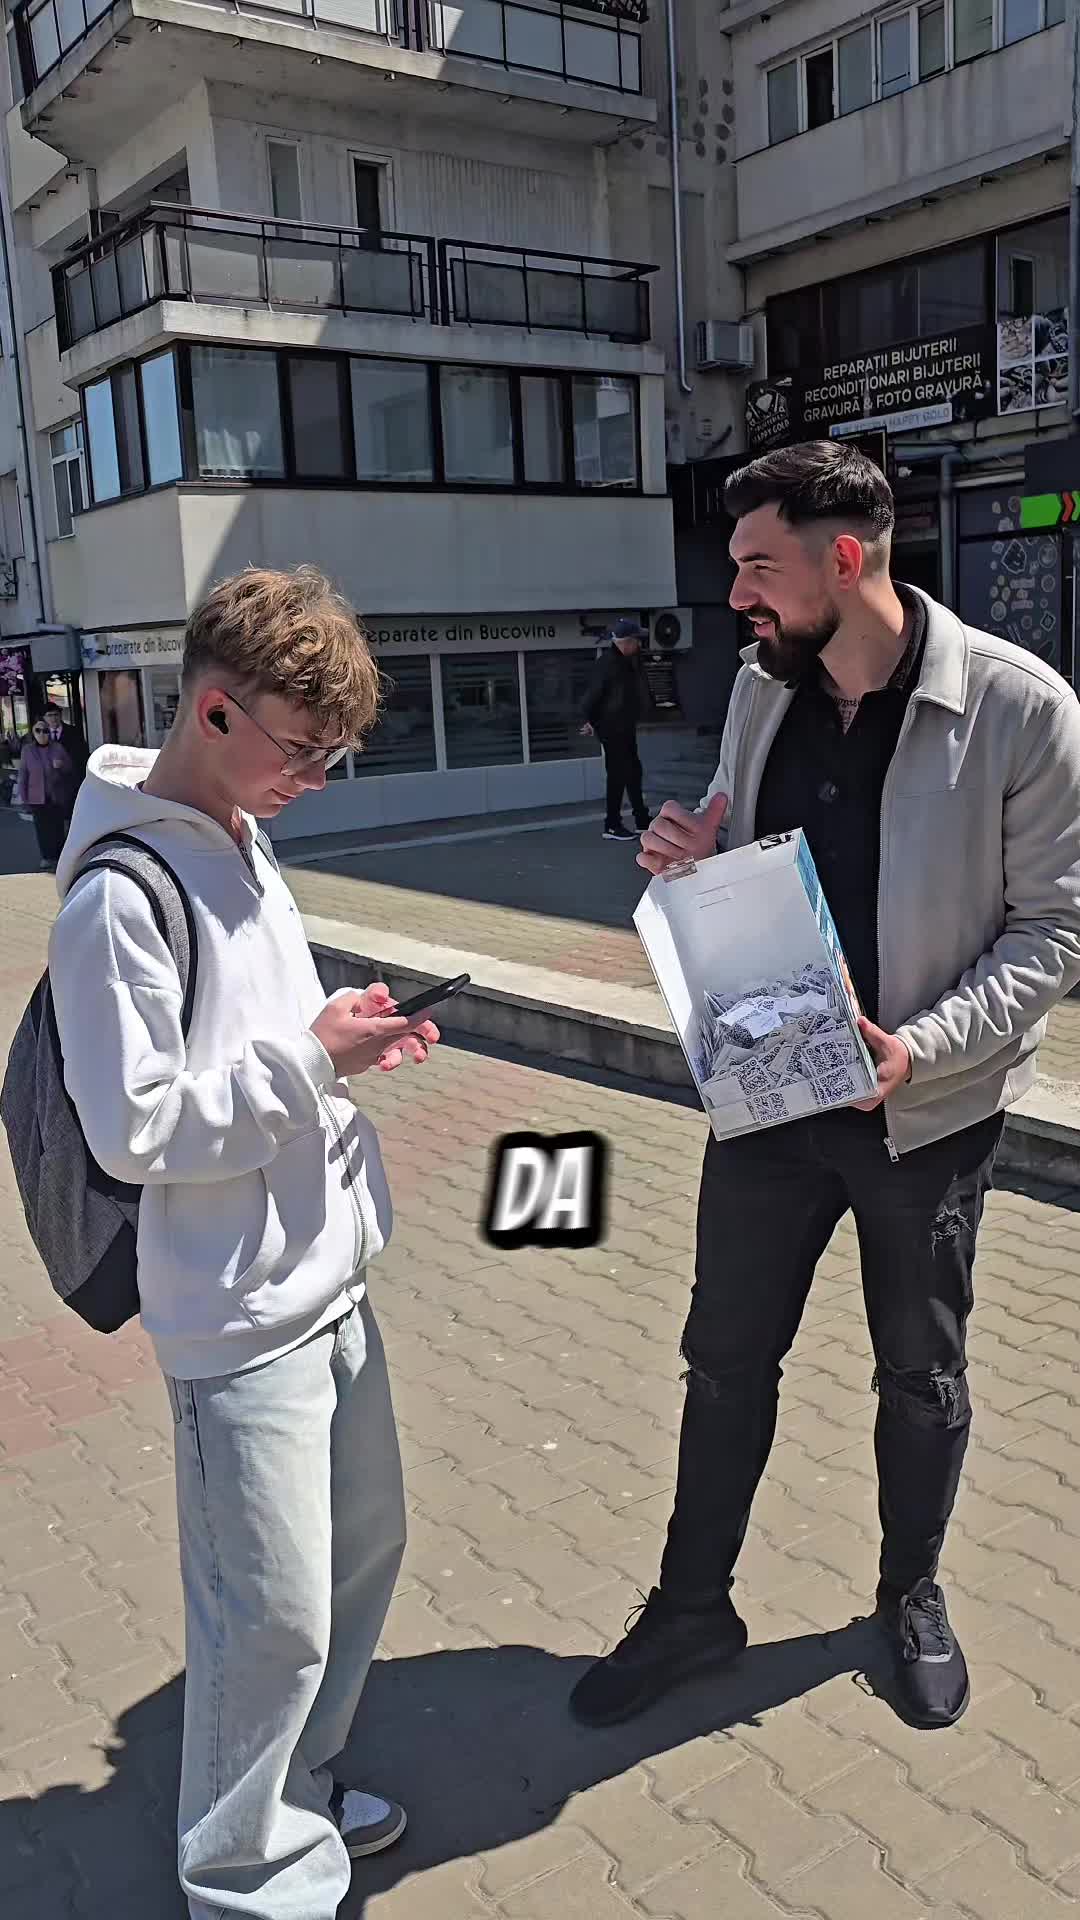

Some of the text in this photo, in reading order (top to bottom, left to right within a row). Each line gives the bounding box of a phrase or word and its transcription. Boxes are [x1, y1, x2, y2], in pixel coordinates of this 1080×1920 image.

[823, 337, 957, 381] REPARAȚII BIJUTERII
[913, 352, 981, 381] BIJUTERII
[863, 397, 873, 410] &
[876, 389, 912, 409] FOTO
[446, 622, 474, 642] din
[479, 623, 556, 641] Bucovina
[143, 638, 156, 653] din
